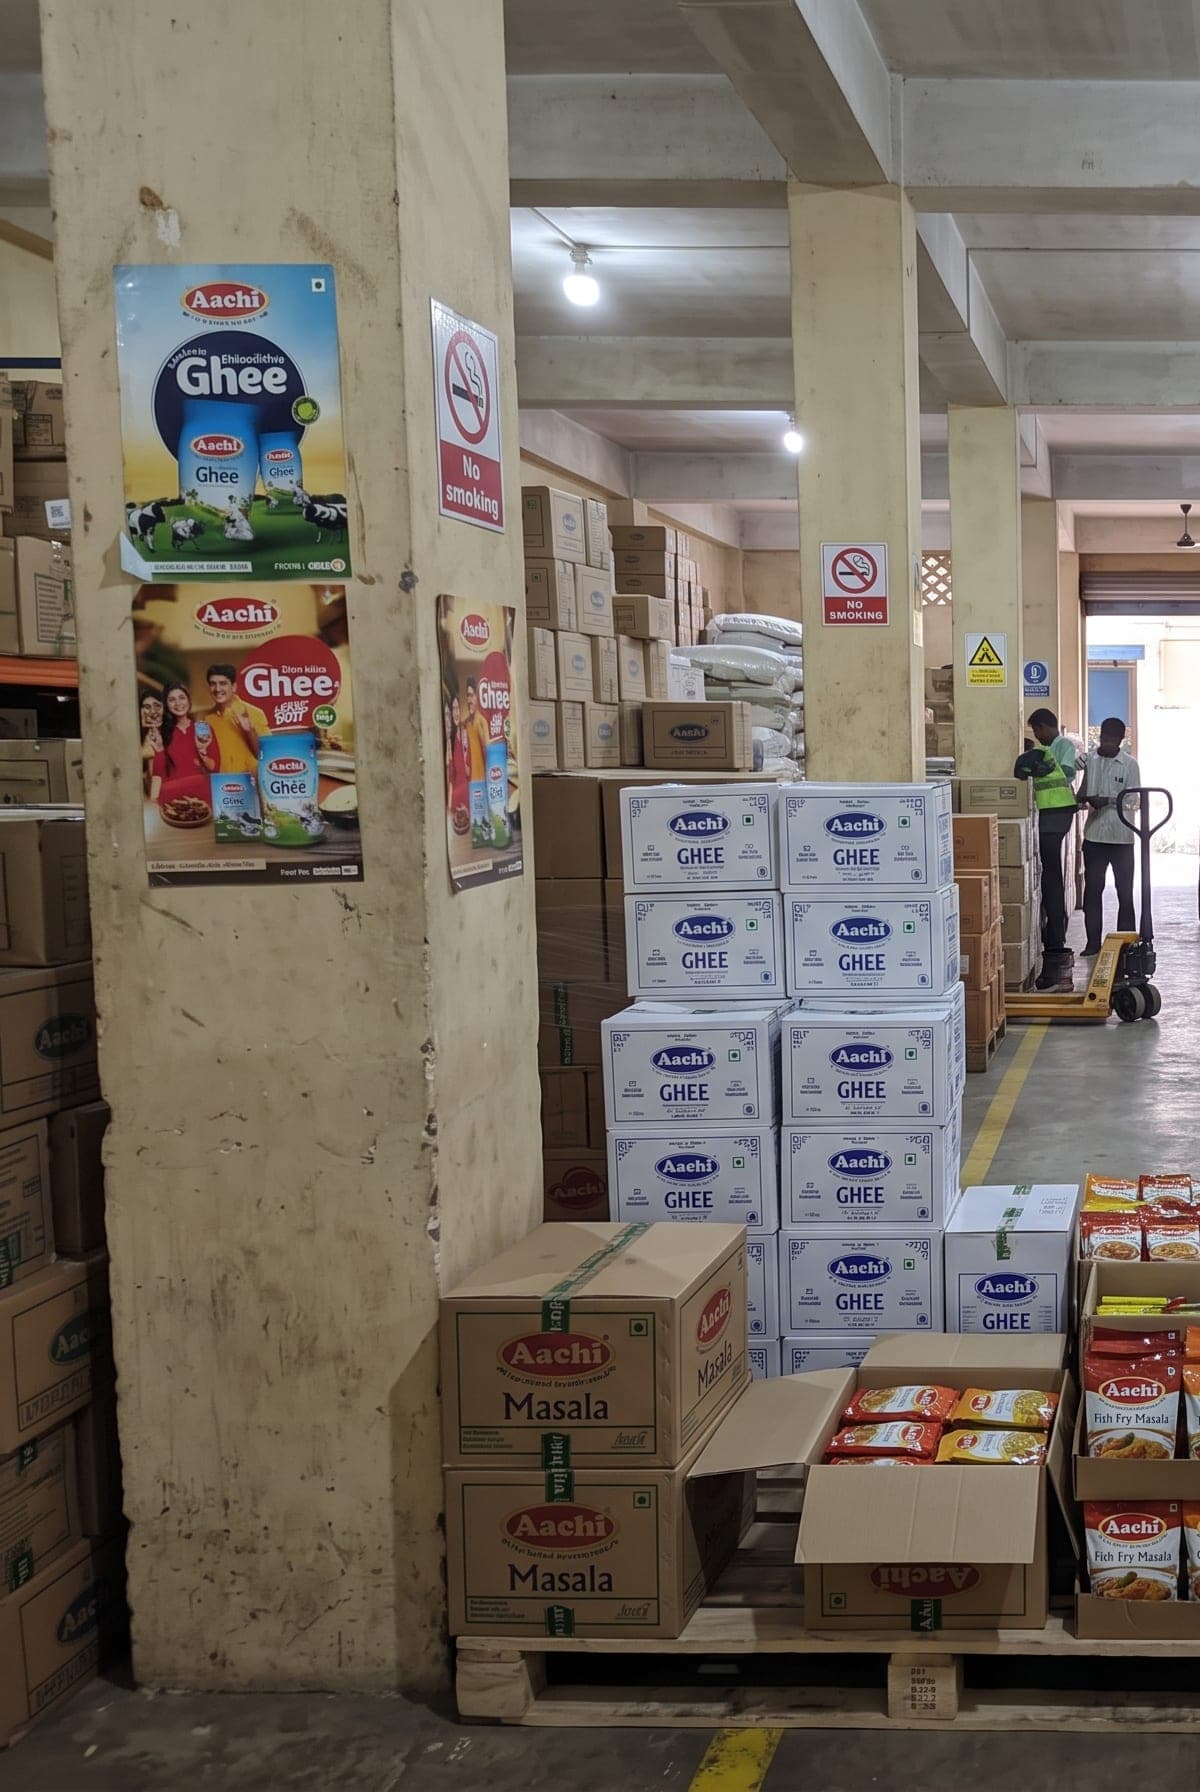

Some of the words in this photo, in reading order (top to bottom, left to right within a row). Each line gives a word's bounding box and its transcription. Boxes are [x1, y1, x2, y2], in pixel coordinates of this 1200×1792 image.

[191, 290, 260, 309] Aachi
[176, 356, 287, 396] Ghee
[195, 466, 239, 484] Ghee
[462, 454, 481, 481] No
[446, 484, 499, 521] smoking
[202, 604, 273, 622] Aachi
[846, 601, 863, 609] NO
[829, 611, 883, 620] SMOKING
[244, 667, 333, 697] Ghee
[479, 679, 510, 711] Ghee
[675, 817, 723, 831] Aachi
[831, 818, 880, 832] Aachi
[677, 848, 725, 864] GHEE
[833, 849, 880, 866] GHEE
[679, 921, 729, 936] Aachi
[837, 923, 887, 937] Aachi
[682, 952, 729, 969] GHEE
[838, 954, 886, 971] GHEE
[658, 1051, 710, 1066] Aachi
[837, 1049, 888, 1064] Aachi
[660, 1084, 709, 1101] GHEE
[837, 1081, 886, 1099] GHEE
[836, 1155, 886, 1170] Aachi
[665, 1192, 713, 1208] GHEE
[836, 1187, 885, 1204] GHEE
[836, 1293, 884, 1310] GHEE
[699, 1290, 731, 1336] Aachi
[983, 1313, 1031, 1330] GHEE
[510, 1341, 602, 1365] Aachi
[697, 1341, 733, 1397] Masala
[503, 1392, 609, 1421] Masala
[1094, 1412, 1114, 1425] Fish
[1116, 1412, 1132, 1426] Fry
[1134, 1412, 1170, 1425] Masala
[513, 1513, 609, 1538] Aachi
[1105, 1519, 1160, 1535] Aachi
[1117, 1551, 1135, 1564] Fry
[1137, 1550, 1173, 1563] Masala
[508, 1564, 614, 1593] Masala
[879, 1567, 973, 1590] Aachi
